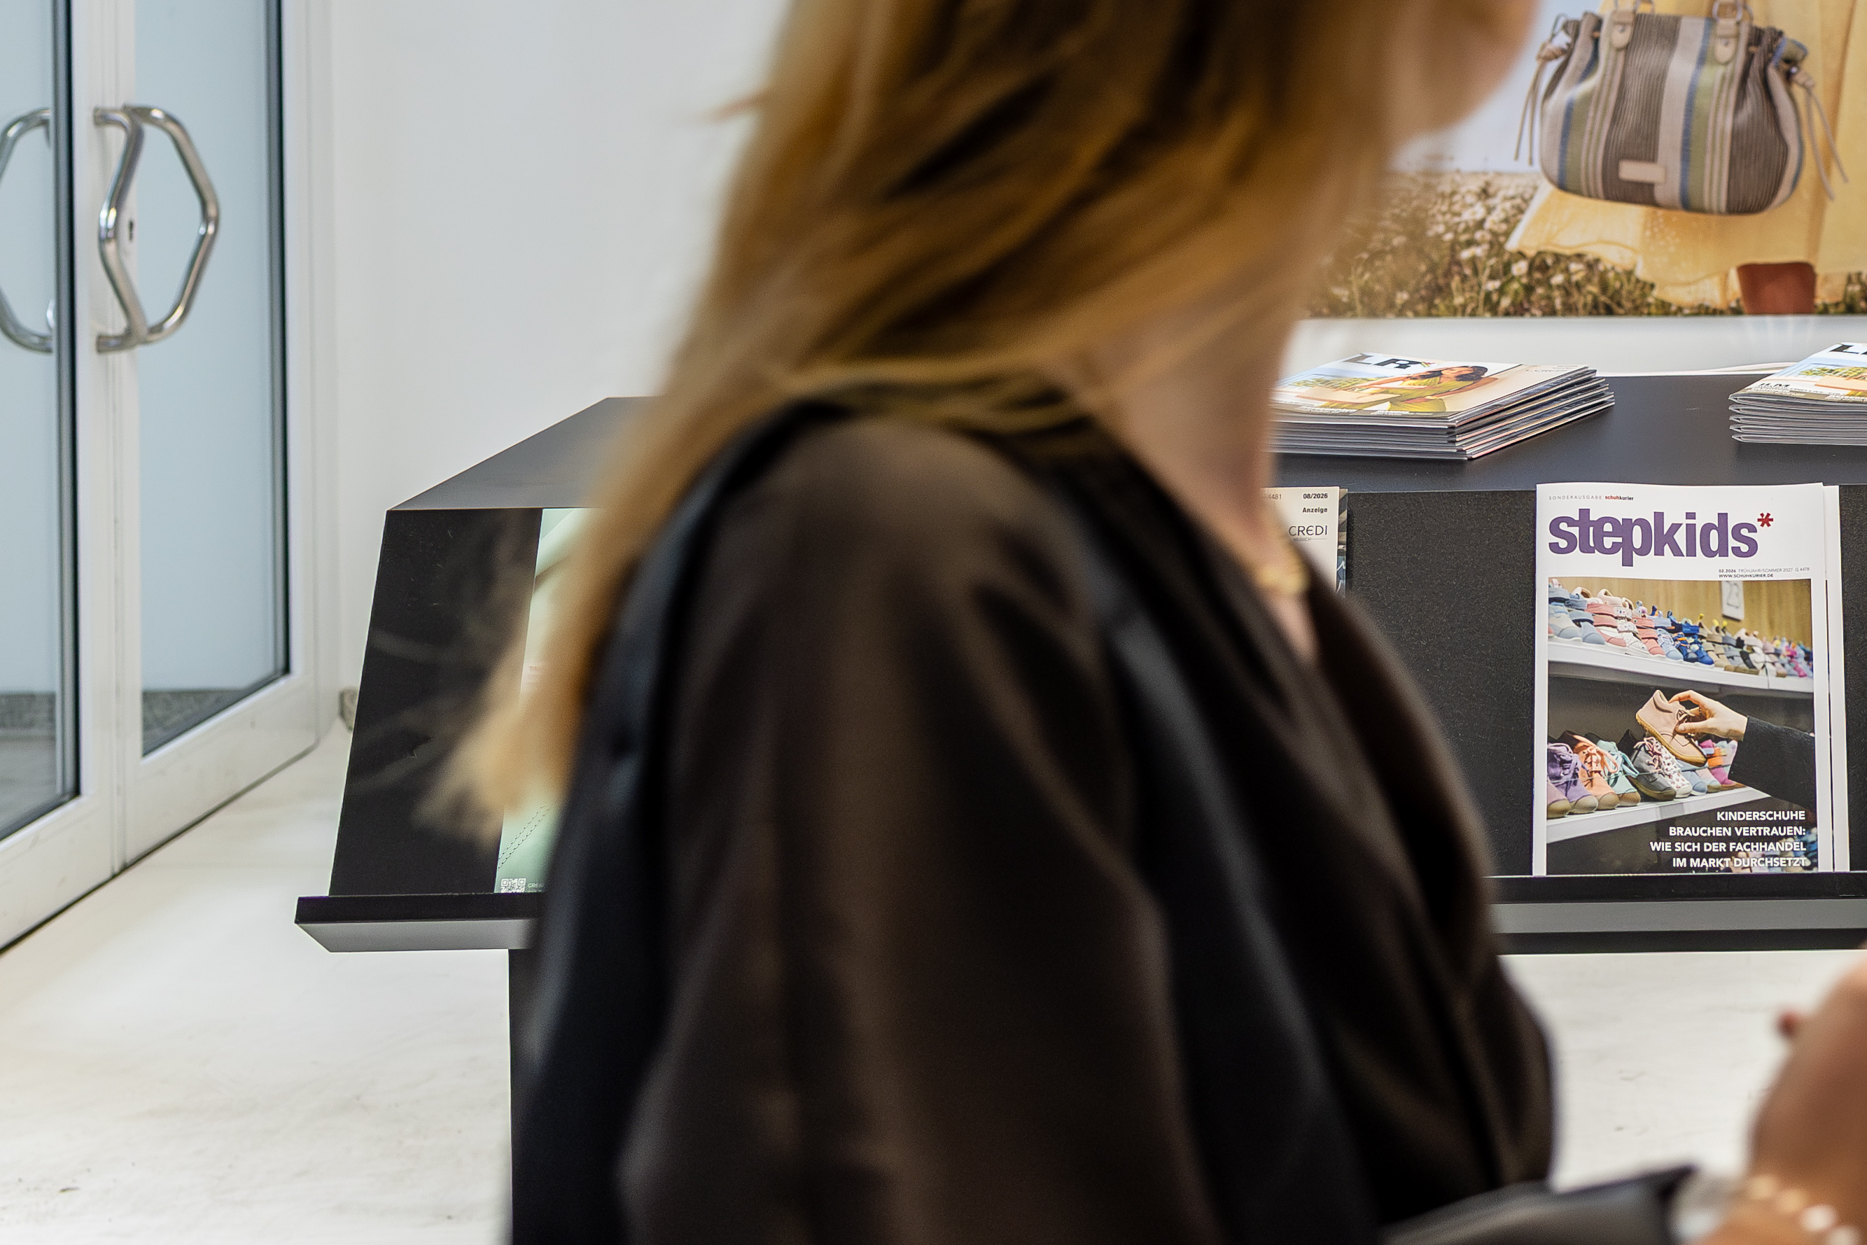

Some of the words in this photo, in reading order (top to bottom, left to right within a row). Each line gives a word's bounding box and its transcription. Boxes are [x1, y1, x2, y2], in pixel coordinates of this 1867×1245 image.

[1604, 494, 1635, 502] schuhkurier
[1716, 810, 1806, 821] KINDERSCHUHE
[1668, 826, 1732, 837] BRAUCHEN
[1734, 825, 1807, 836] VERTRAUEN:
[1650, 841, 1672, 852] WIE
[1674, 841, 1701, 852] SICH
[1703, 842, 1727, 852] DER
[1729, 841, 1807, 852] FACHHANDEL
[1672, 857, 1687, 868] IM
[1689, 857, 1731, 868] MARKT
[1734, 857, 1807, 868] DURCHSETZT
